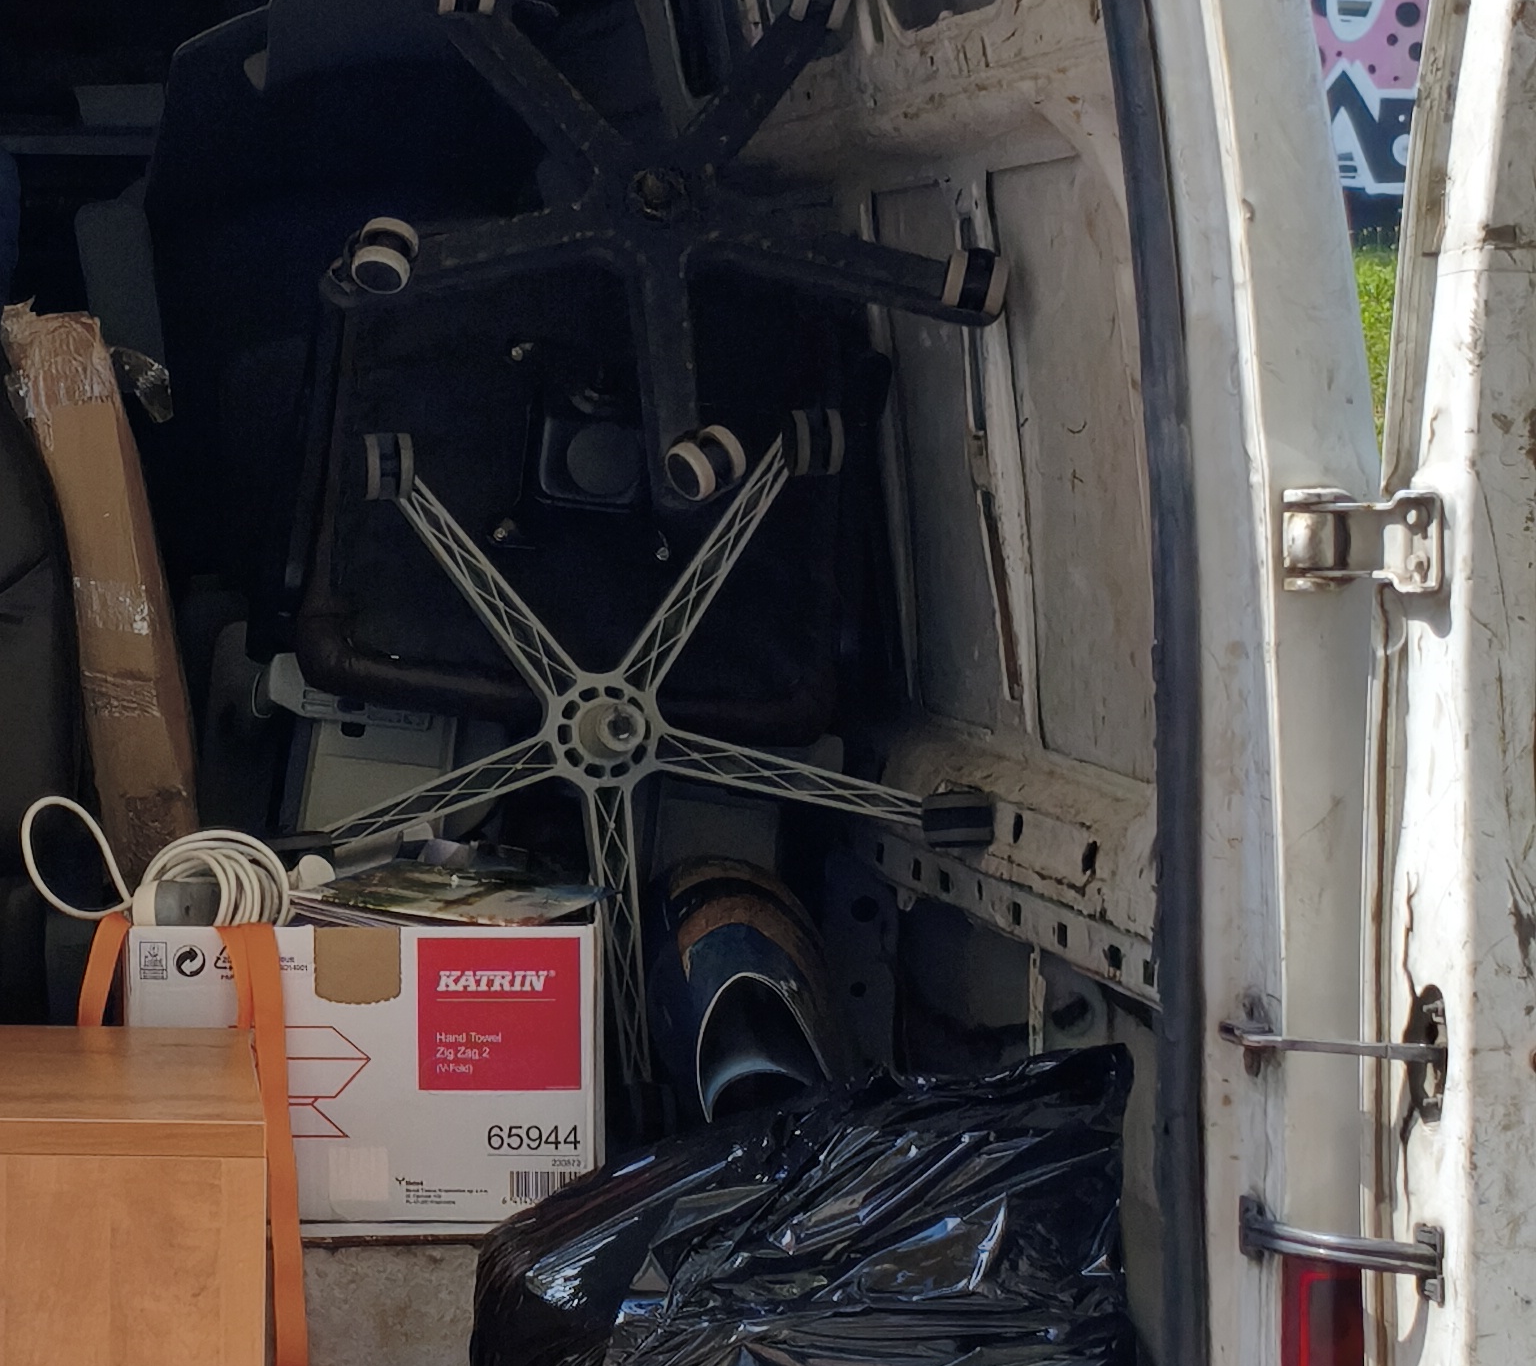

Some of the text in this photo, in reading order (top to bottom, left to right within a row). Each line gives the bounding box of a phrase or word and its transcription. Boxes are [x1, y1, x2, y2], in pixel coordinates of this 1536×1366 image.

[436, 970, 548, 991] KATRIN
[436, 1032, 502, 1043] Hand Towel
[436, 1046, 490, 1060] Zig Zag 2
[487, 1124, 581, 1150] 65944
